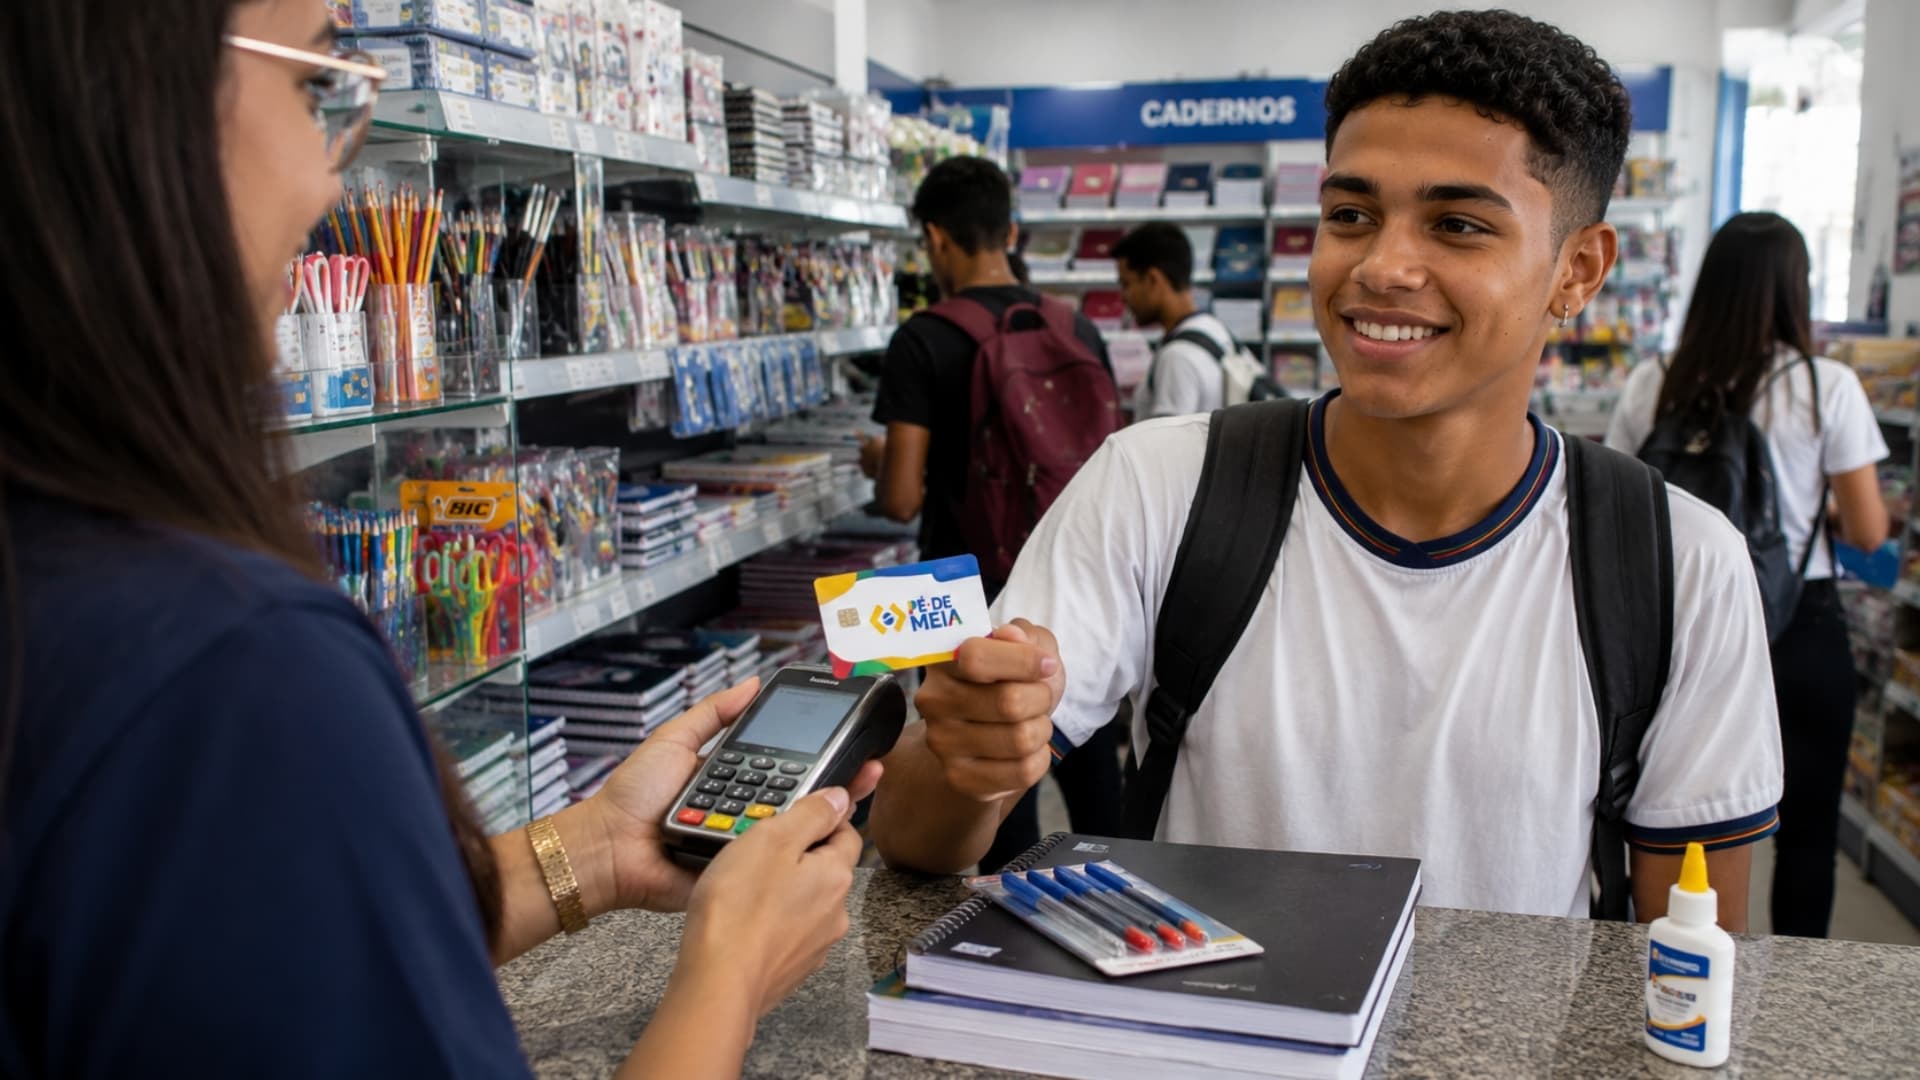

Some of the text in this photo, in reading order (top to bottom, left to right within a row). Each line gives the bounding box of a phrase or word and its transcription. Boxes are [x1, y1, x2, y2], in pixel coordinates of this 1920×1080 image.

[1141, 96, 1296, 128] CADERNOS
[448, 502, 490, 516] BIC
[910, 609, 962, 631] MEIA
